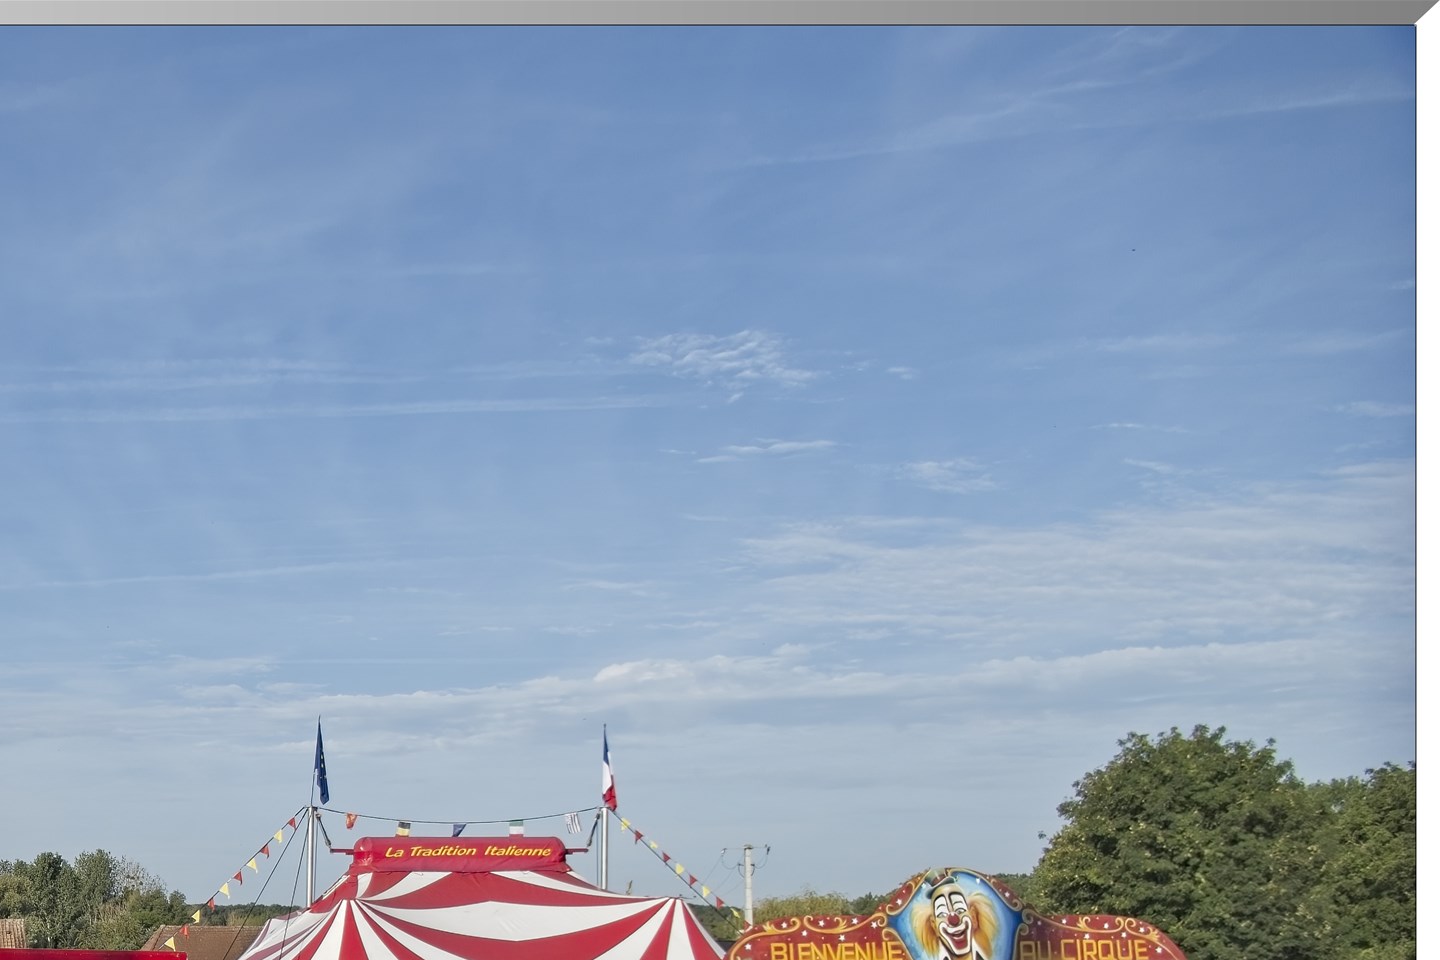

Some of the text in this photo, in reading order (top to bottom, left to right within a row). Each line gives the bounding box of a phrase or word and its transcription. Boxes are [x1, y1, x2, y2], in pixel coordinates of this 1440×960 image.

[385, 844, 552, 858] La Tradition Italienne
